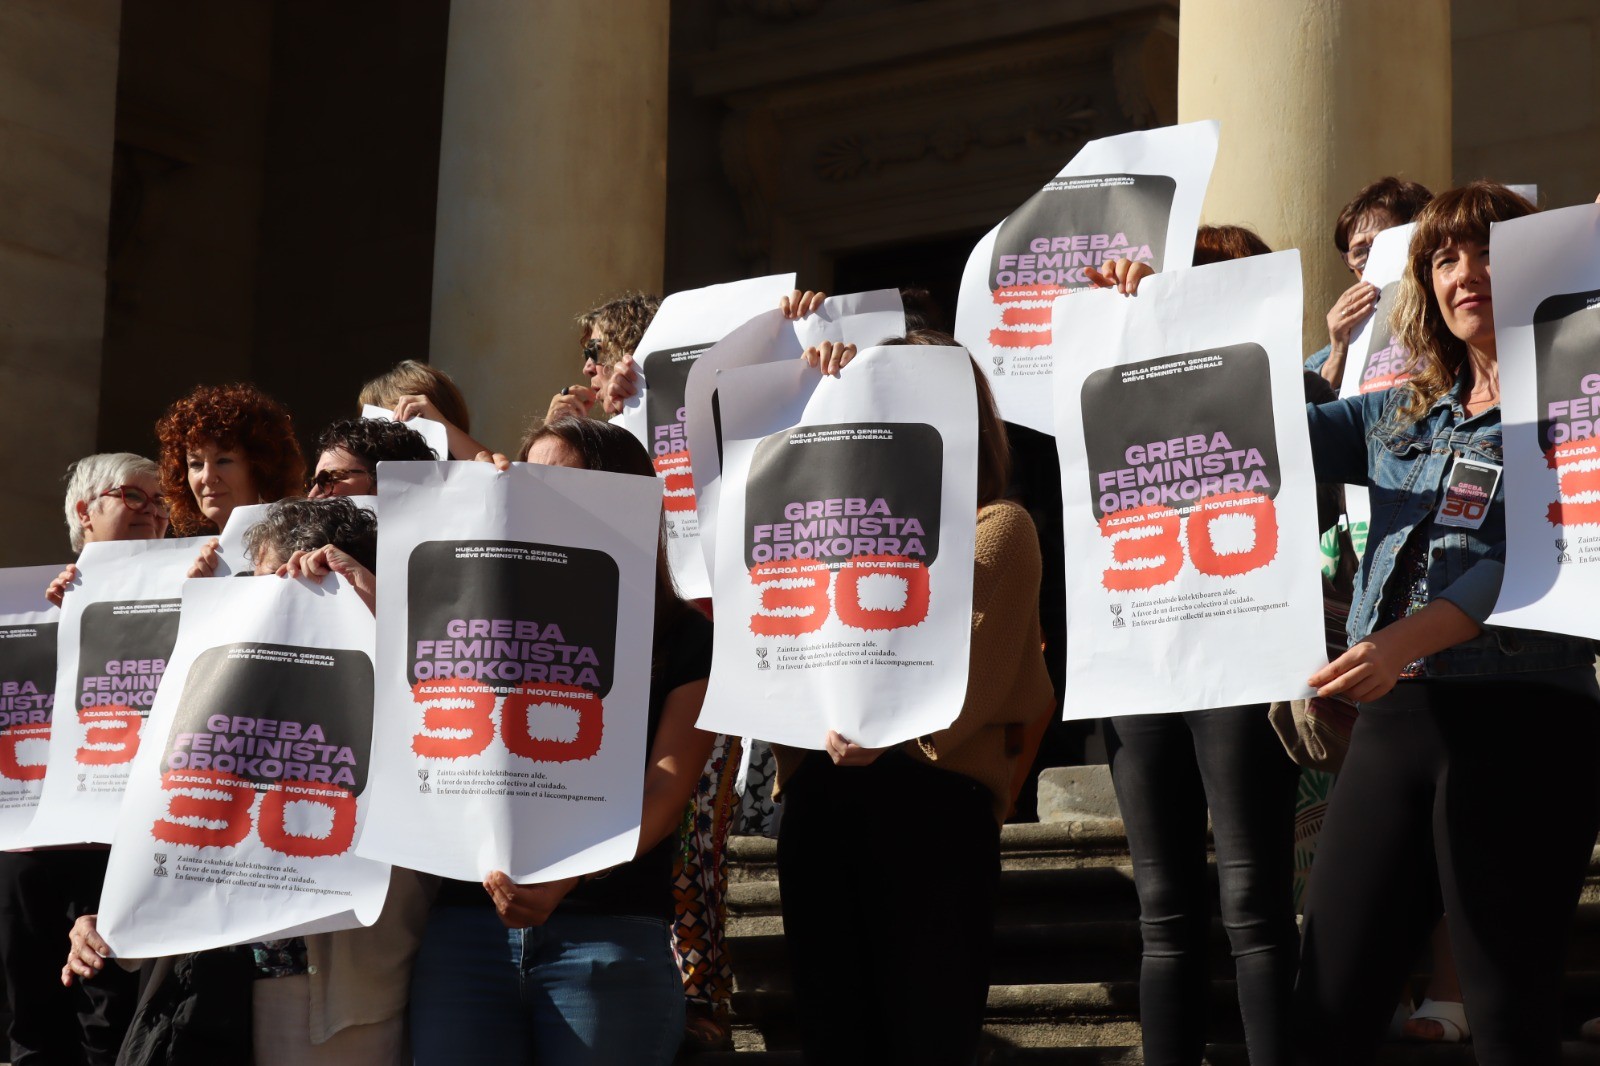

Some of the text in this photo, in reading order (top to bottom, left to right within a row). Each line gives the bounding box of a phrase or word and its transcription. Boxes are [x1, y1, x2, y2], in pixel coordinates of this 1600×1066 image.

[1030, 232, 1128, 254] GREBA
[999, 244, 1153, 270] FEMINISTA
[1122, 354, 1223, 377] HUELGA FEMINISTA GENERAL
[1125, 431, 1232, 466] GREBA
[1554, 446, 1597, 458] AZAROA
[658, 457, 689, 465] AZAROA
[1098, 448, 1266, 493] FEMINISTA
[1099, 470, 1270, 514] OROKORRA
[1458, 482, 1482, 492] GREBA
[784, 498, 892, 521] GREBA
[1106, 496, 1265, 527] AZAROA NOVIEMBRE NOVEMBRE
[754, 518, 925, 543] FEMINISTA
[531, 550, 568, 559] GENERAL
[752, 538, 926, 563] OROKORRA
[756, 561, 920, 575] AZAROA NOVIEMBRE NOVEMBRE
[446, 620, 566, 643] GREBA
[257, 649, 298, 658] FEMINISTA
[416, 640, 600, 666] FEMINISTA
[106, 659, 166, 675] GREB
[414, 660, 600, 687] OROKORRA
[83, 674, 161, 691] FEMINI
[419, 686, 594, 700] AZAROA NOVIEMBRE NOVEMBRE
[80, 690, 156, 707] OROKO
[207, 714, 326, 743] GREBA
[174, 733, 357, 766] FEMINISTA
[168, 752, 356, 785] OROKORRA
[531, 772, 548, 780] alde.
[168, 775, 349, 798] AZAROA NOVIEMBRE NOVEMBRE
[537, 782, 567, 790] cuidado.
[178, 856, 299, 874] Zaintza eskubide kolektiboaren alde.
[183, 865, 200, 873] favor
[221, 869, 248, 877] derecho
[250, 872, 279, 880] colectivo
[185, 874, 205, 882] faveur
[232, 879, 259, 888] collectif
